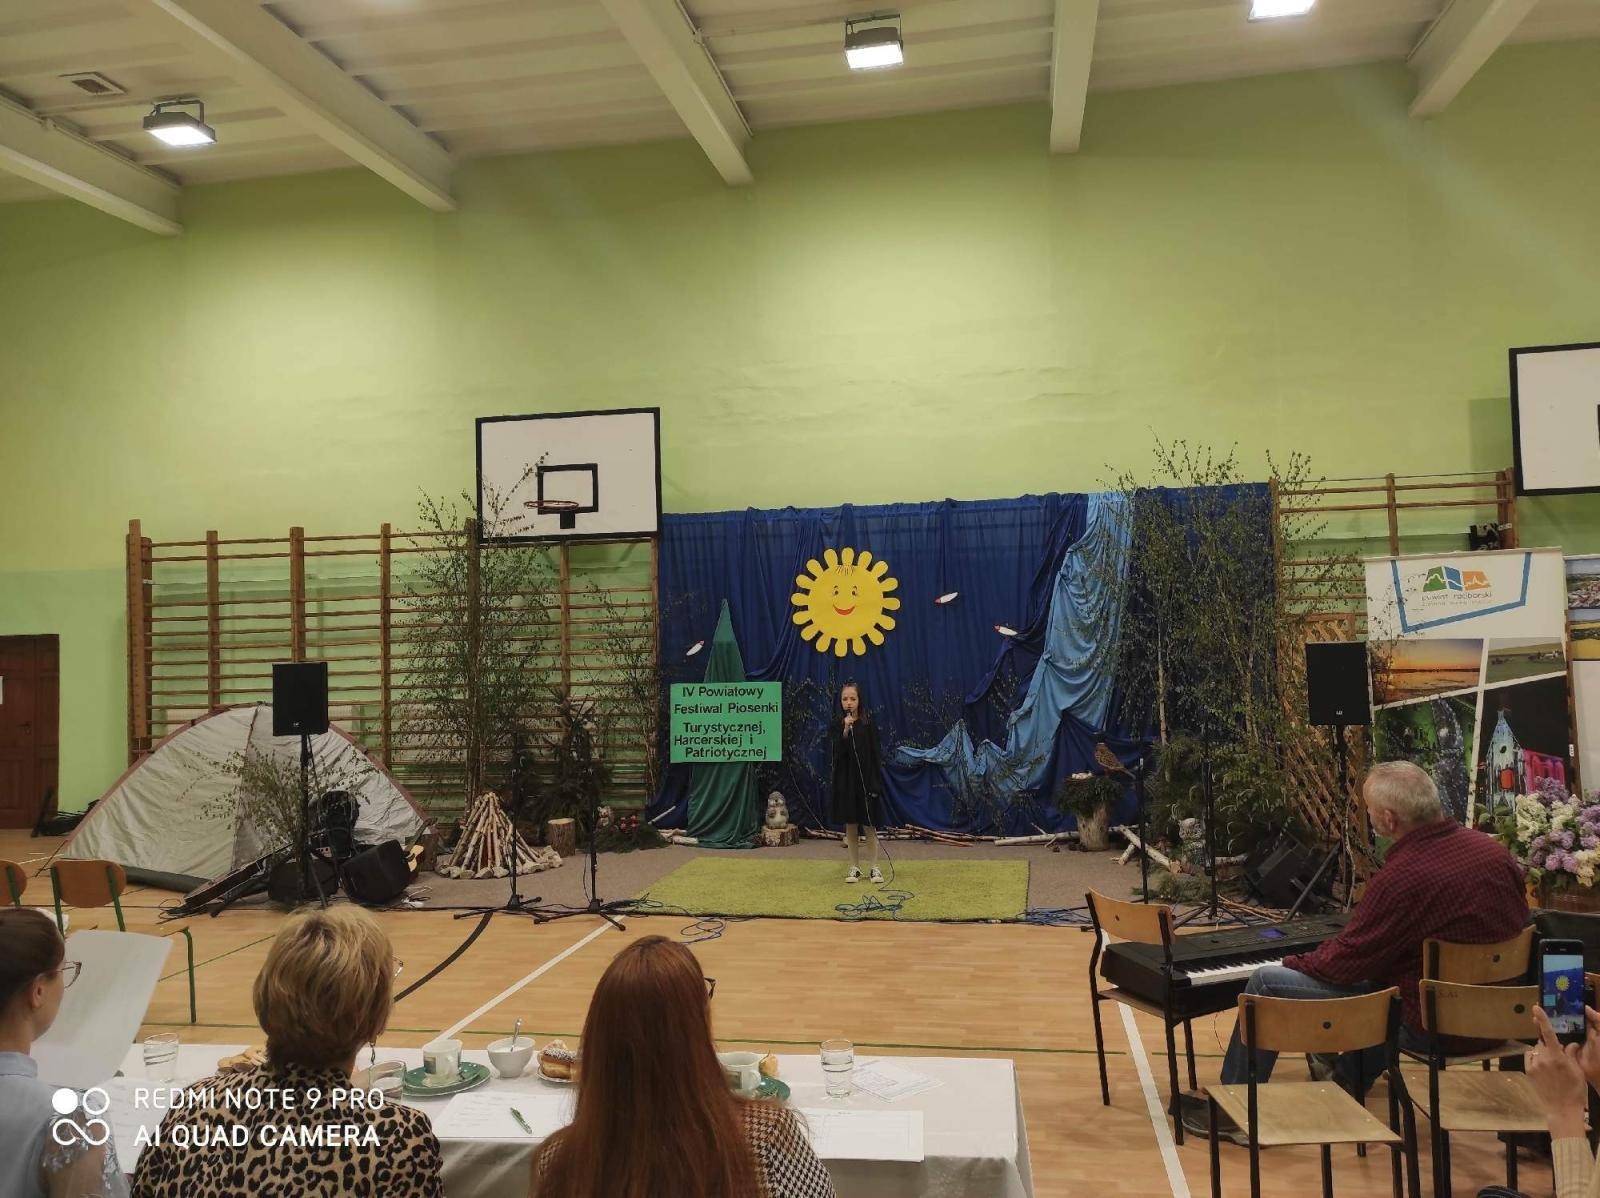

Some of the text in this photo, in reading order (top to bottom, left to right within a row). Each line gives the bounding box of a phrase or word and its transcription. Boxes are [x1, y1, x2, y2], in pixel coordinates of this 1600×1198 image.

[682, 687, 764, 699] IV Powiatowy
[674, 702, 779, 714] Festiwal Piosenki
[683, 721, 766, 735] Turystycznej,
[674, 734, 754, 747] Harcerskiej i
[685, 746, 767, 760] Patriotycznej
